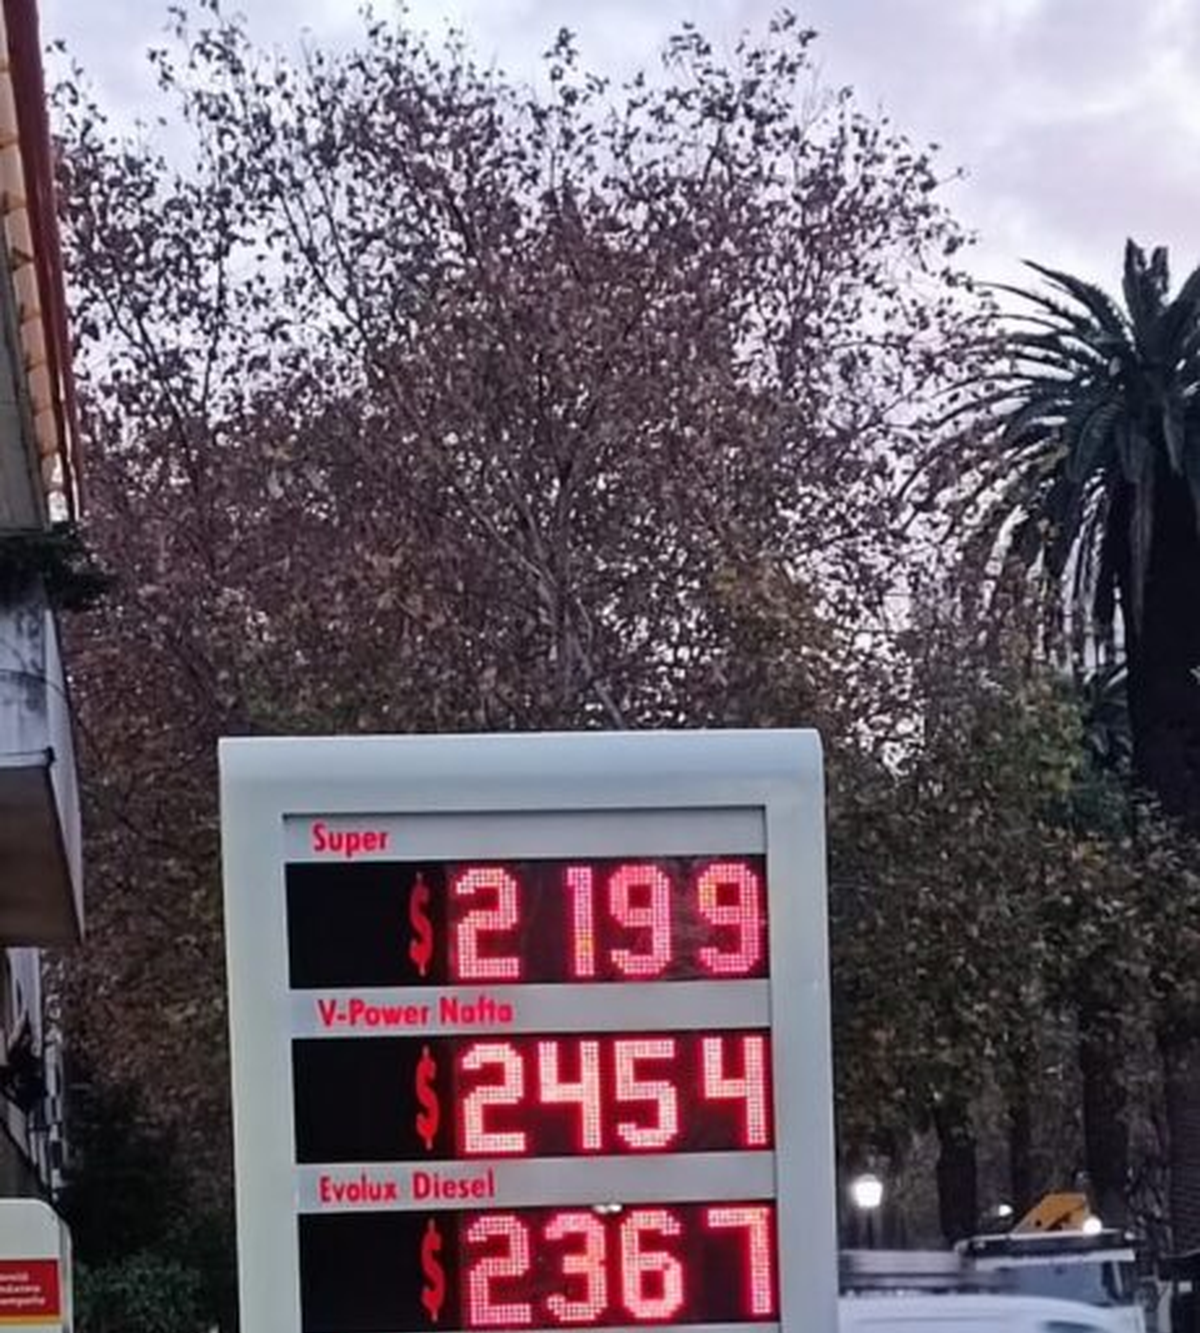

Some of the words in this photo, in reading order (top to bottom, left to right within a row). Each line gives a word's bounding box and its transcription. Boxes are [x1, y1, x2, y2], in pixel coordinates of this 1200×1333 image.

[313, 823, 389, 858] Super
[456, 863, 763, 979] 2199
[318, 998, 430, 1027] V-Power
[440, 996, 513, 1025] Nafta
[463, 1036, 768, 1153] 2454
[320, 1173, 397, 1202] Evolux
[412, 1167, 495, 1199] Diesel
[468, 1207, 772, 1325] 2367
